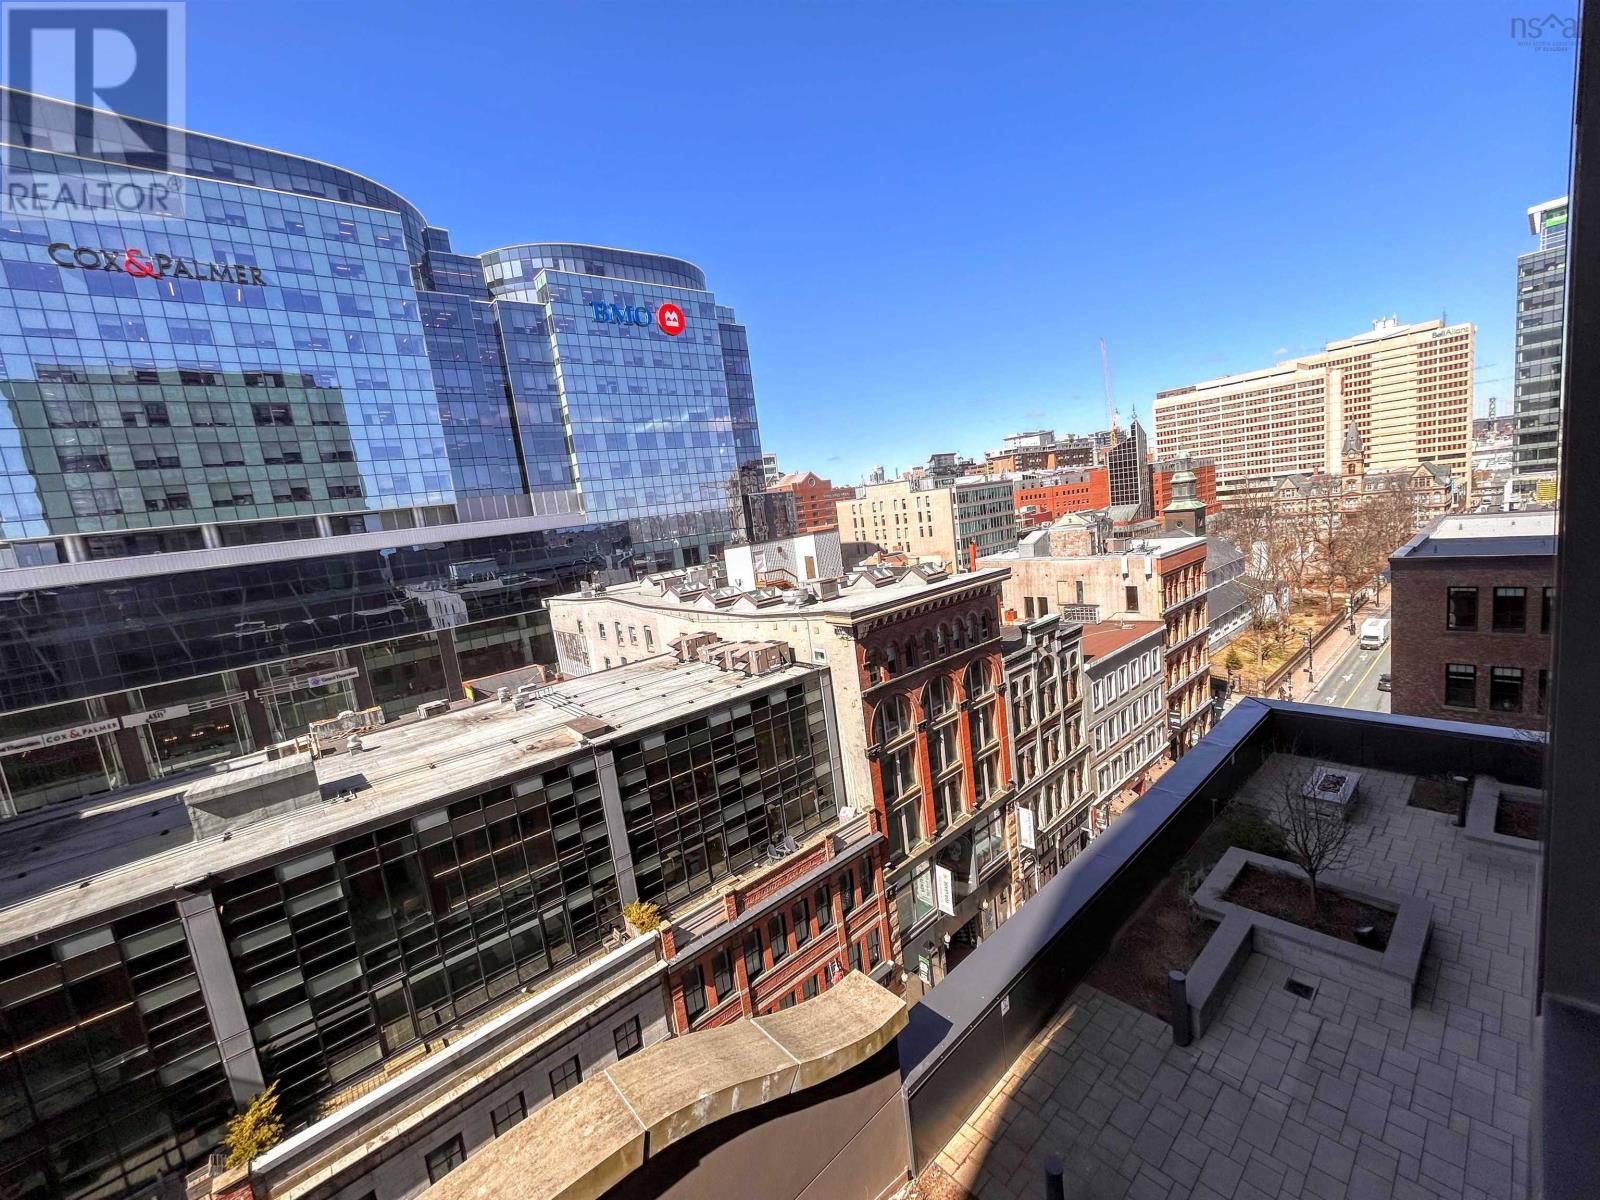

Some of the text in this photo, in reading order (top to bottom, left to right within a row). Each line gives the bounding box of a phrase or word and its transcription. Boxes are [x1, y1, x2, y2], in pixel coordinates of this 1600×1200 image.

[589, 301, 652, 327] BMO
[46, 722, 117, 743] COX & PALMER
